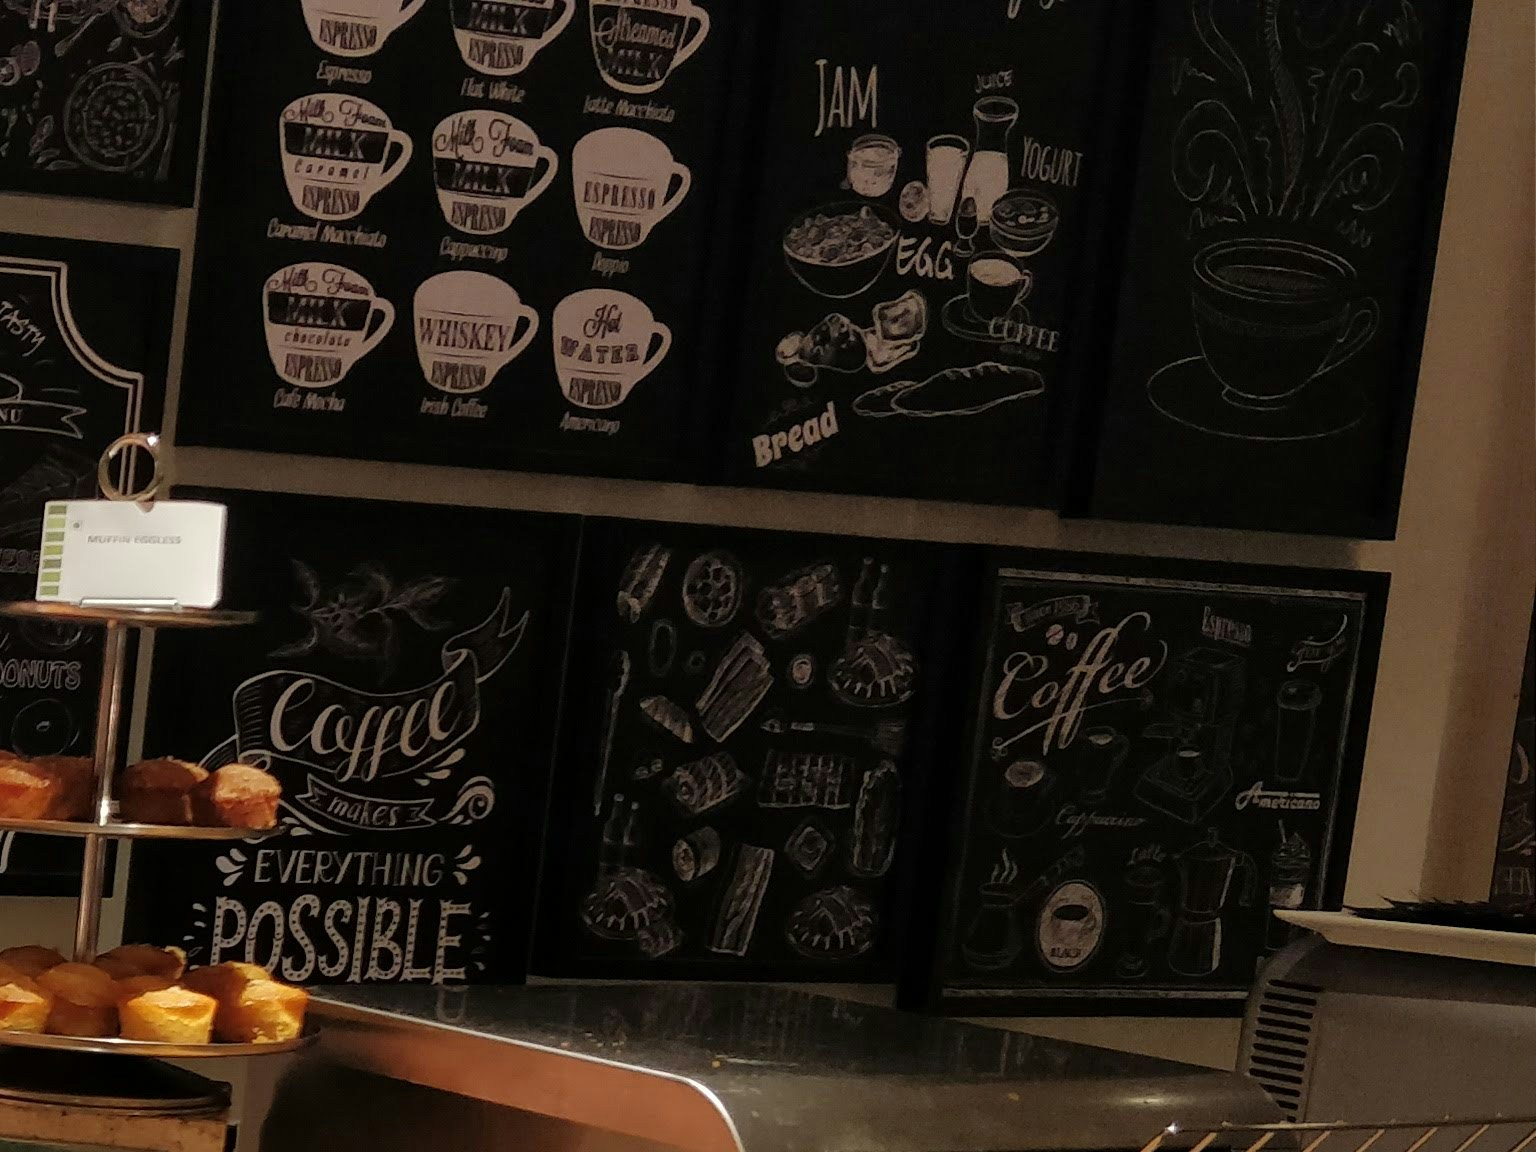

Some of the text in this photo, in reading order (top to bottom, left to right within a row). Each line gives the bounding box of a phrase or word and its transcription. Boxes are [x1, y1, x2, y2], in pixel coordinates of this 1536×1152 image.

[813, 58, 878, 137] JAM
[1020, 136, 1084, 187] YOGURT
[584, 181, 656, 210] ESPRESSO
[895, 235, 955, 280] EGG
[419, 317, 512, 352] WHISKEY
[560, 335, 639, 364] WATER
[988, 315, 1061, 353] COFFEE
[751, 401, 839, 468] Bread
[993, 611, 1169, 758] Coffee
[269, 677, 463, 783] Coffee
[327, 794, 401, 828] makes
[253, 849, 447, 887] EVERYTHING
[211, 893, 473, 986] POSSIBLE
